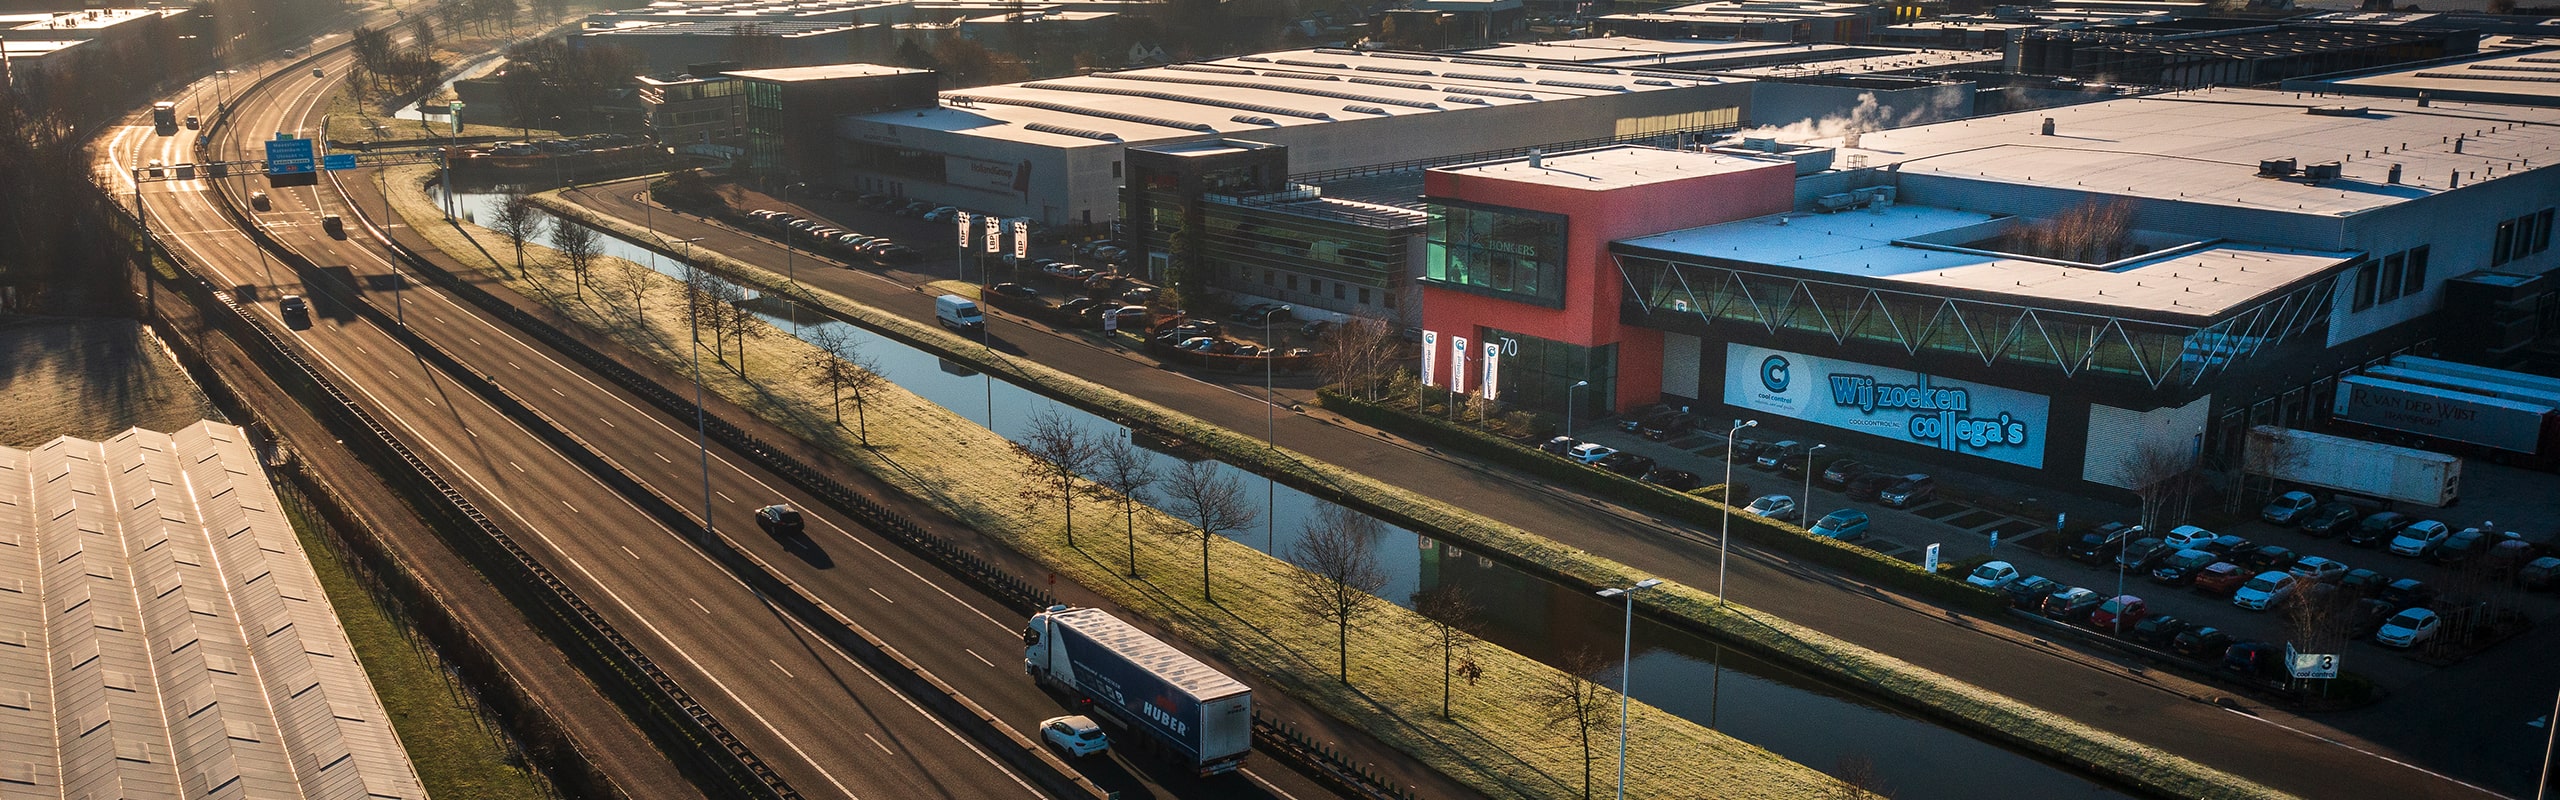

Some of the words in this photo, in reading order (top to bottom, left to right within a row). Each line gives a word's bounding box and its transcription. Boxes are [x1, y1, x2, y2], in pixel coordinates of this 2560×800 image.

[1489, 240, 1535, 257] BONGERS
[1500, 337, 1518, 357] 70
[1771, 395, 1792, 404] control
[1830, 374, 1873, 412] Wij
[1877, 373, 1967, 412] zoeken
[2384, 411, 2443, 427] TRANSPORT
[1911, 411, 2024, 451] collega's
[2321, 656, 2332, 670] 3
[1144, 701, 1186, 737] HUBER
